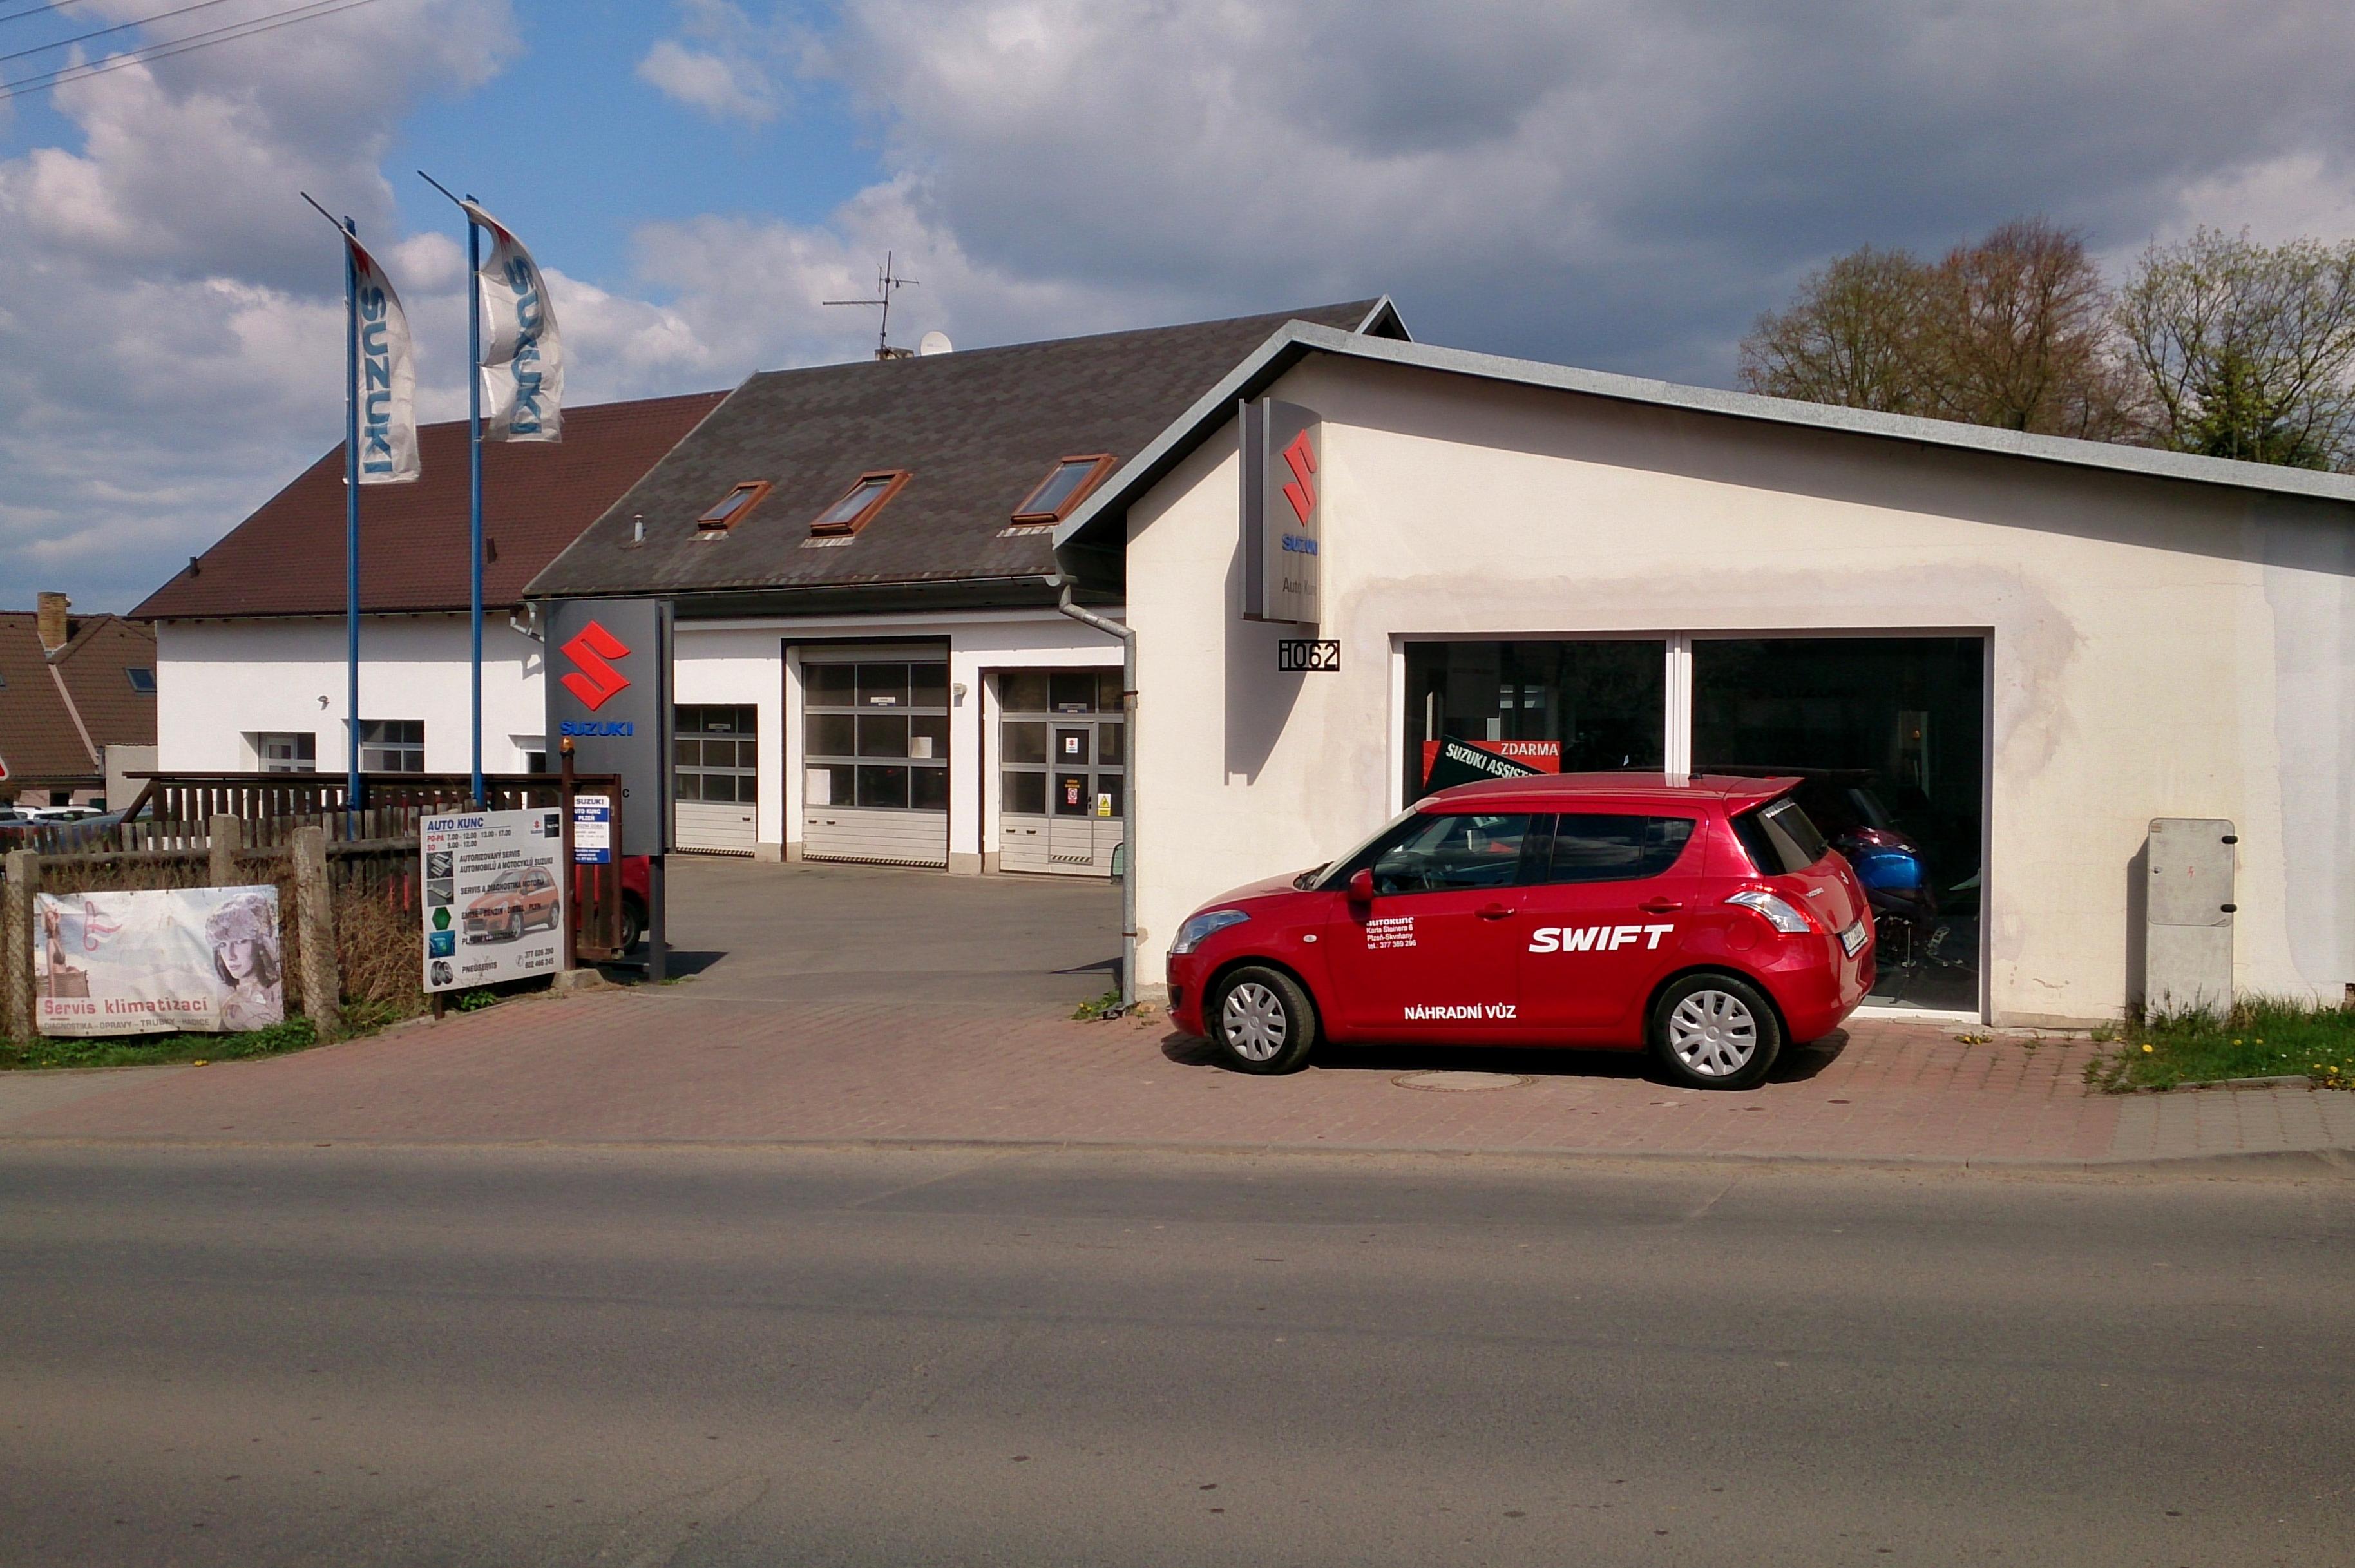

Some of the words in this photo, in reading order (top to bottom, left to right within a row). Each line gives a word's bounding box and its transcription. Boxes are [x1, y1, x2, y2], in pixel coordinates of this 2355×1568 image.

[360, 287, 393, 473] SUZUKI
[1282, 577, 1302, 594] Auto
[1280, 642, 1338, 670] 1062
[559, 720, 634, 736] SUZUKI
[1501, 743, 1559, 756] ZDARMA
[1445, 743, 1487, 769] SUZUKI
[1486, 760, 1534, 779] ASSIST
[427, 820, 453, 831] AUTO
[457, 817, 484, 828] KUNC
[459, 849, 501, 862] AUTORIZOVANÝ
[502, 850, 520, 858] SERVIS
[460, 862, 496, 873] AUTOMOBILŮ
[502, 857, 533, 869] MOTOCYKLŮ
[534, 857, 553, 866] SUZUKI
[461, 886, 481, 895] SERVIS
[487, 881, 521, 892] DIAGNOSTIKA
[1529, 924, 1675, 953] SWIFT
[462, 962, 497, 973] PNEUSERVIS
[44, 999, 97, 1015] Servis
[104, 997, 208, 1014] klimatizací
[1404, 1003, 1482, 1020] NÁHRADNÍ
[1485, 1002, 1516, 1018] VŮZ
[44, 1022, 93, 1030] DIAGNOSTIKA
[140, 1018, 175, 1027] TRUBKY
